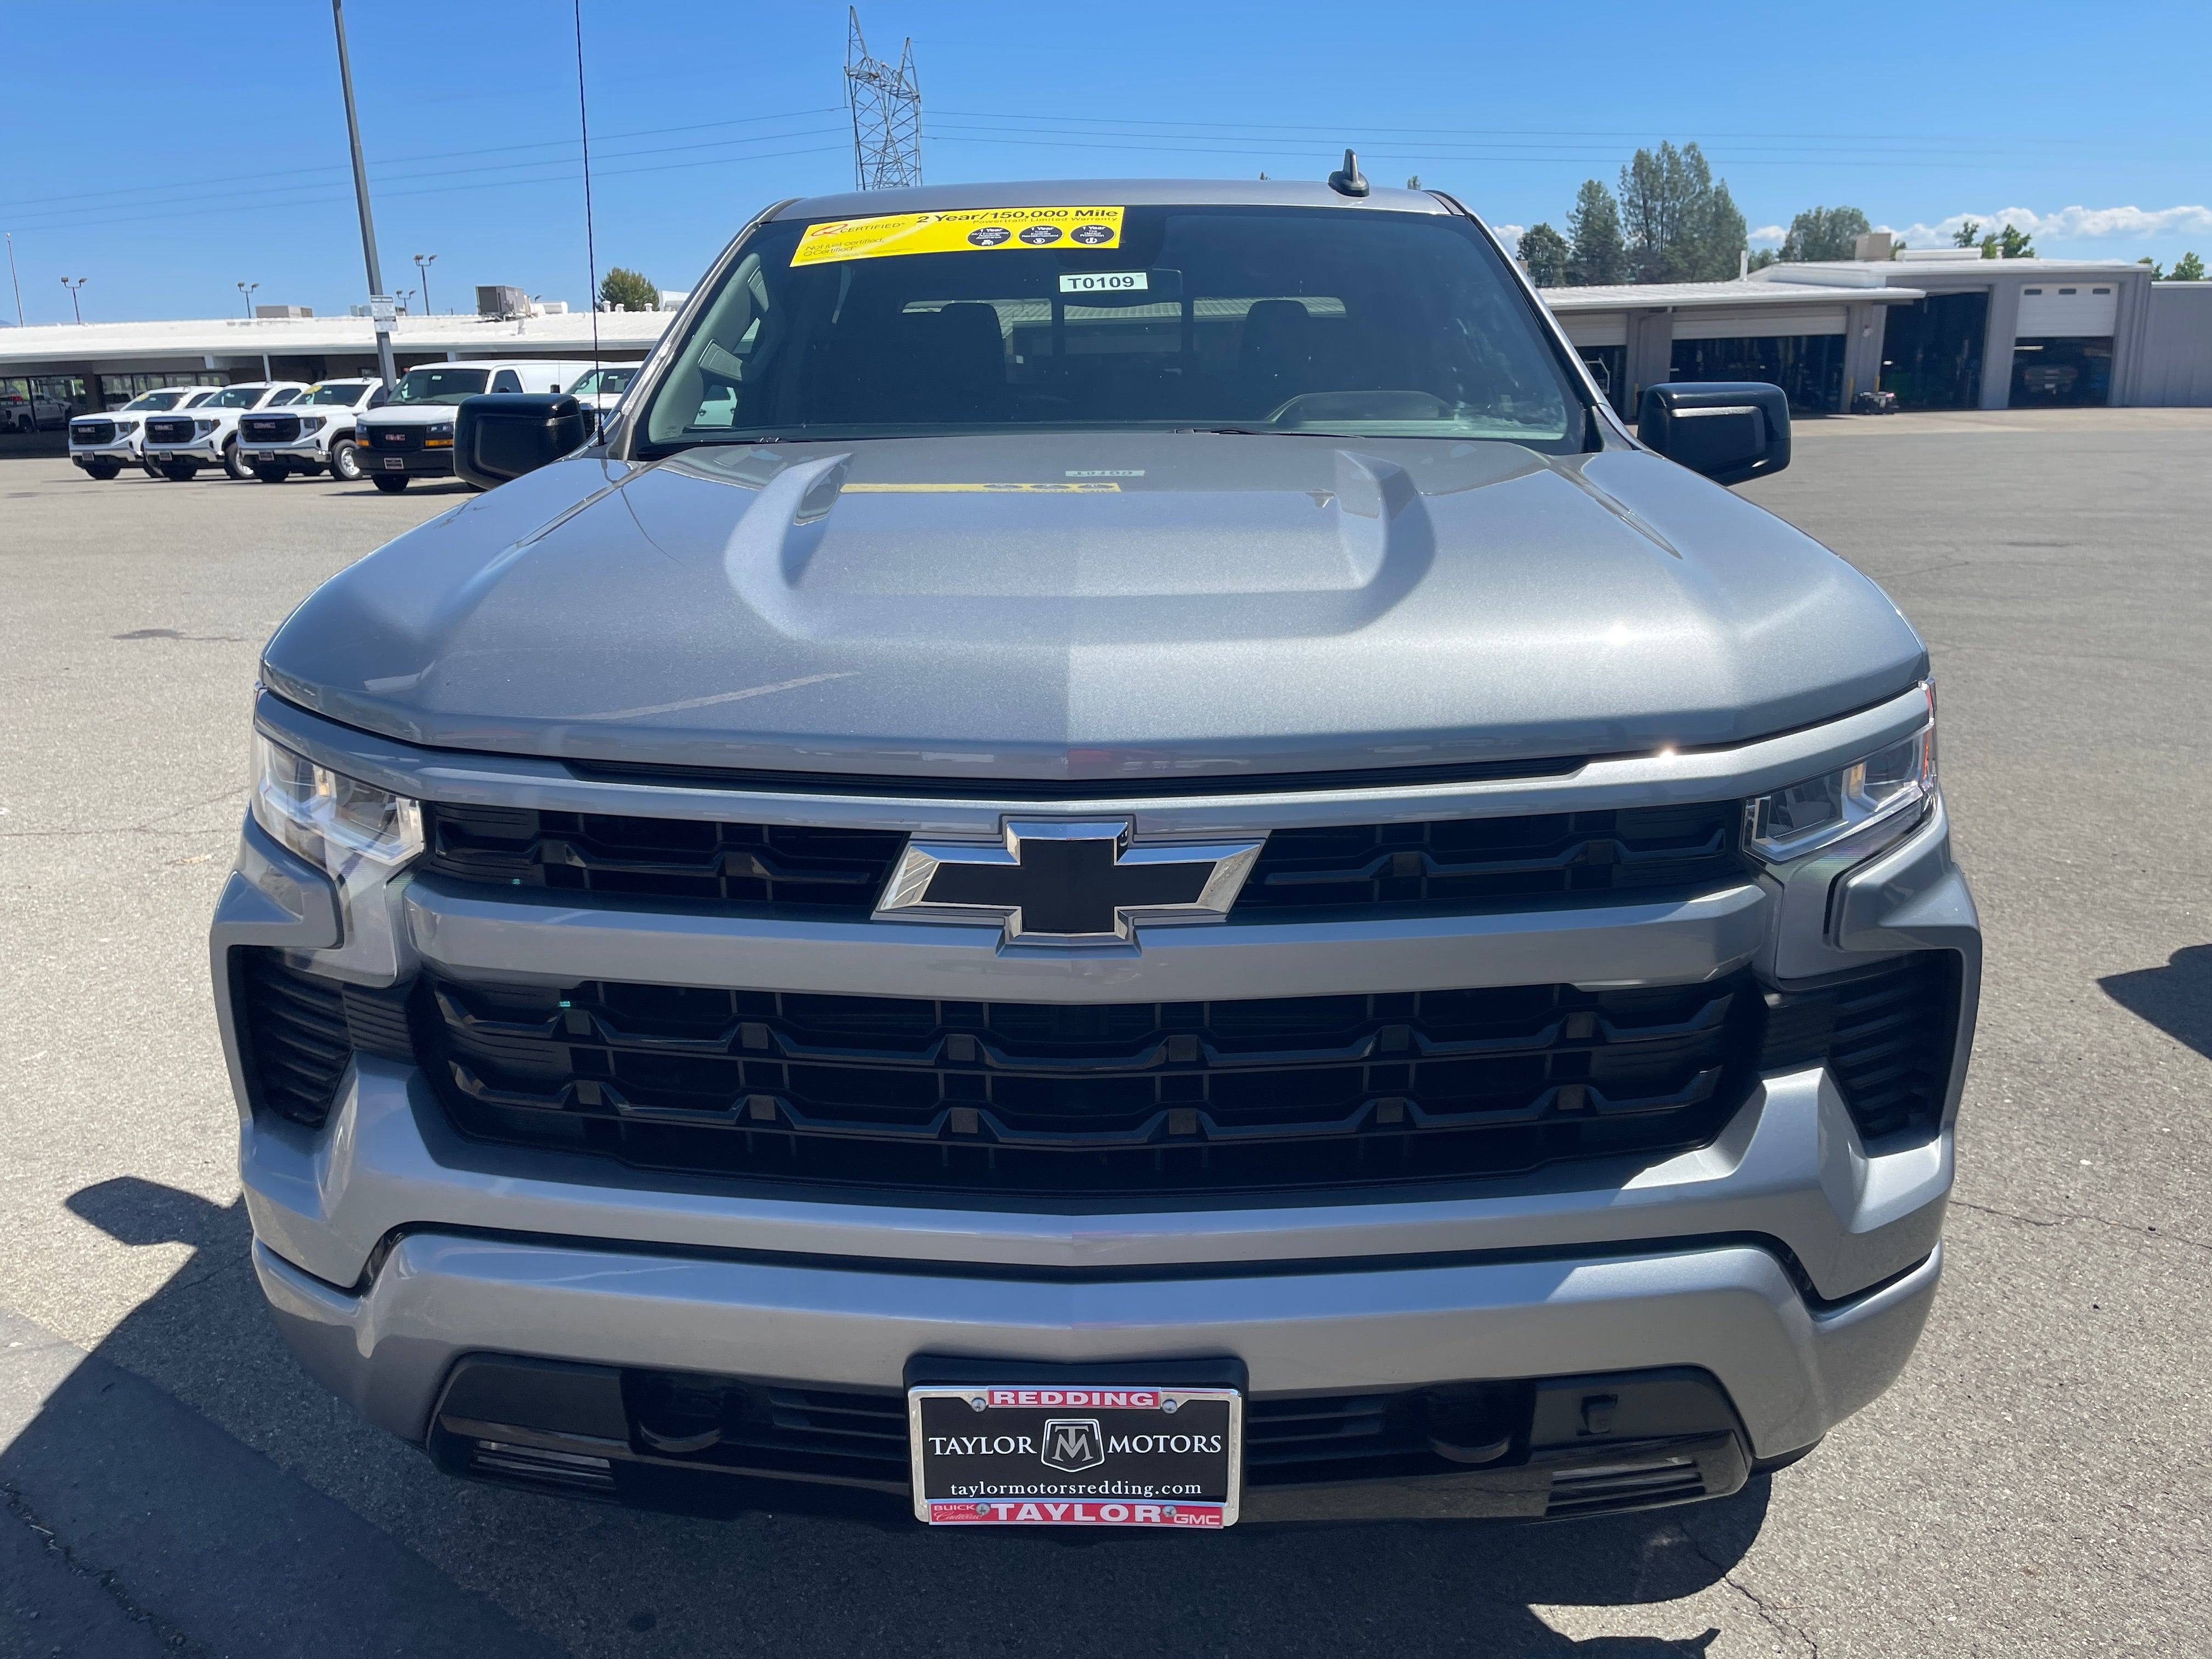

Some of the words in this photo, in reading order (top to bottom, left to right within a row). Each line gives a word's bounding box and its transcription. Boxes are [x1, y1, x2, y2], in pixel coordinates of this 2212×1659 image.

[935, 211, 1068, 222] Year/150,000
[1068, 276, 1134, 289] T0109
[994, 1391, 1154, 1406] REDDING
[928, 1436, 1037, 1455] TAYLOR
[1107, 1435, 1221, 1453] MOTORS
[951, 1481, 1202, 1498] taylormotorsredding.com
[990, 1504, 1161, 1522] TAYLOR
[1174, 1514, 1220, 1525] GMC
